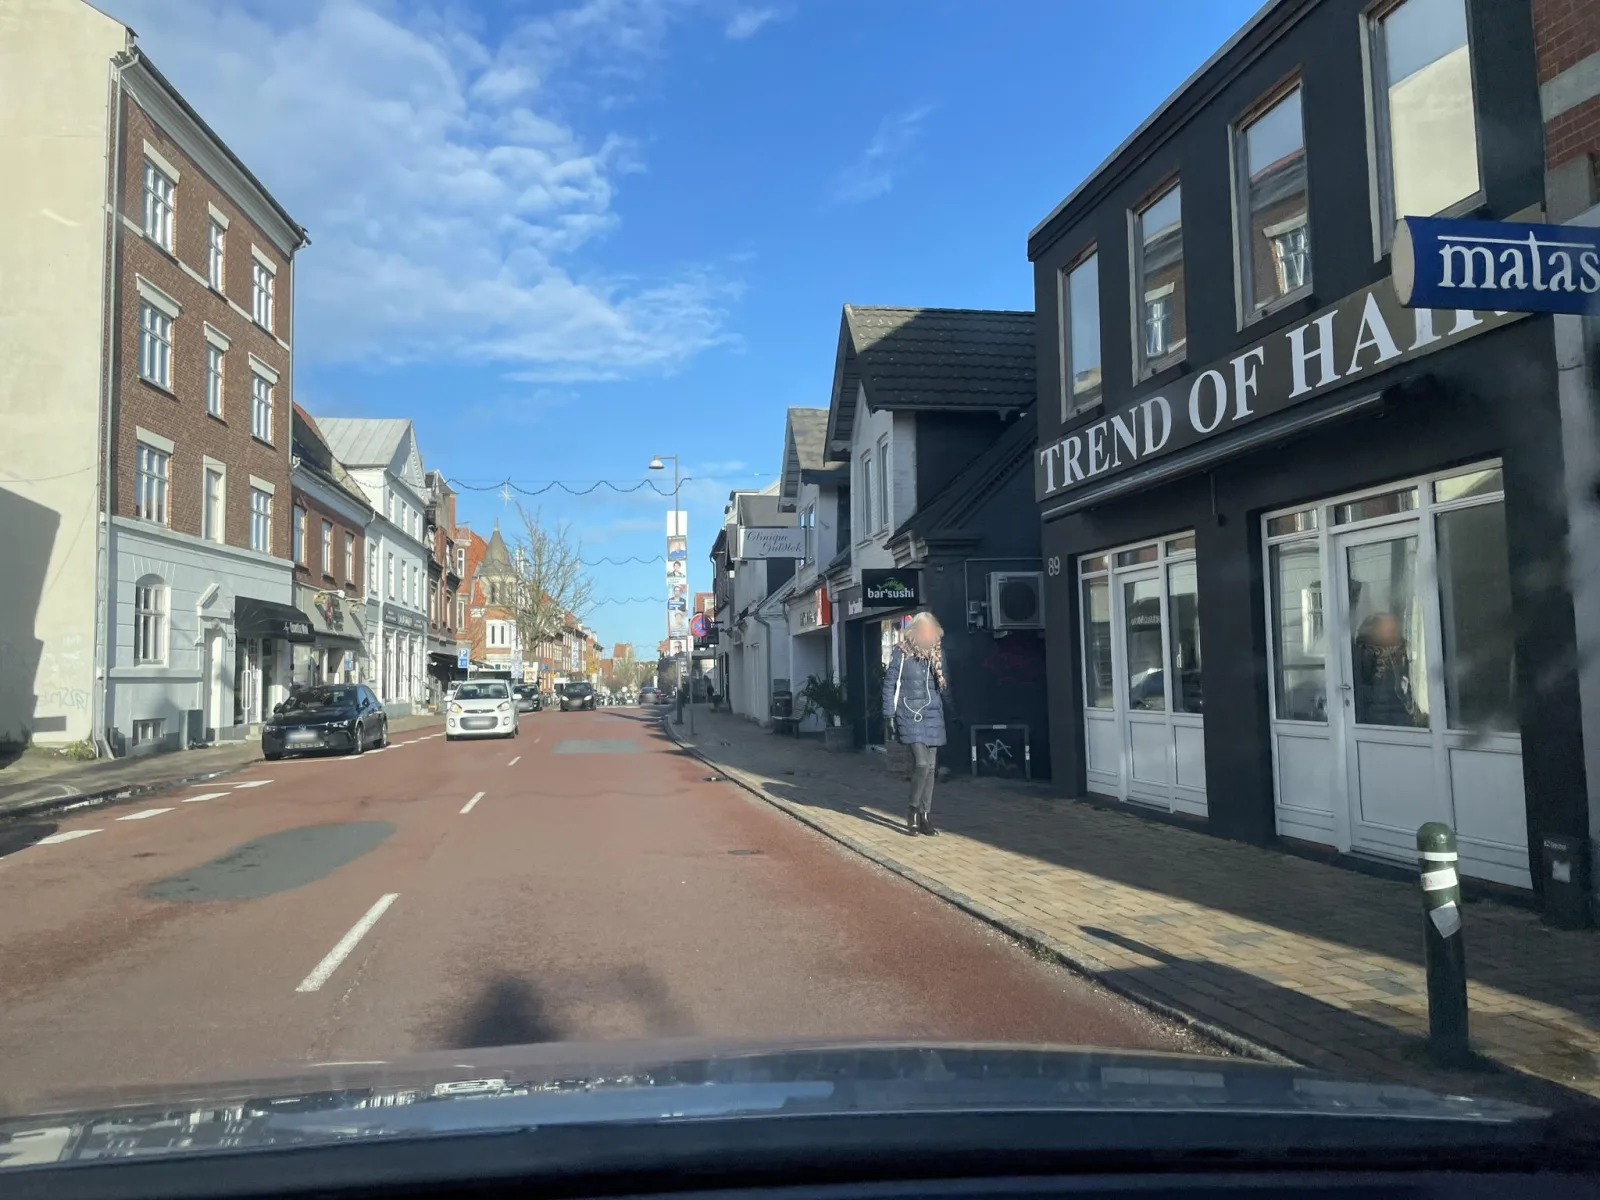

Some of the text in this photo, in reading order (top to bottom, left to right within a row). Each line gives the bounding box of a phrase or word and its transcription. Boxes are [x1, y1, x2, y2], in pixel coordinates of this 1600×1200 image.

[1437, 231, 1600, 293] matas
[1040, 396, 1172, 493] TREND
[1188, 346, 1264, 433] OF
[747, 531, 788, 545] Clinique
[1048, 555, 1060, 576] 89
[867, 587, 915, 598] bar'sushi
